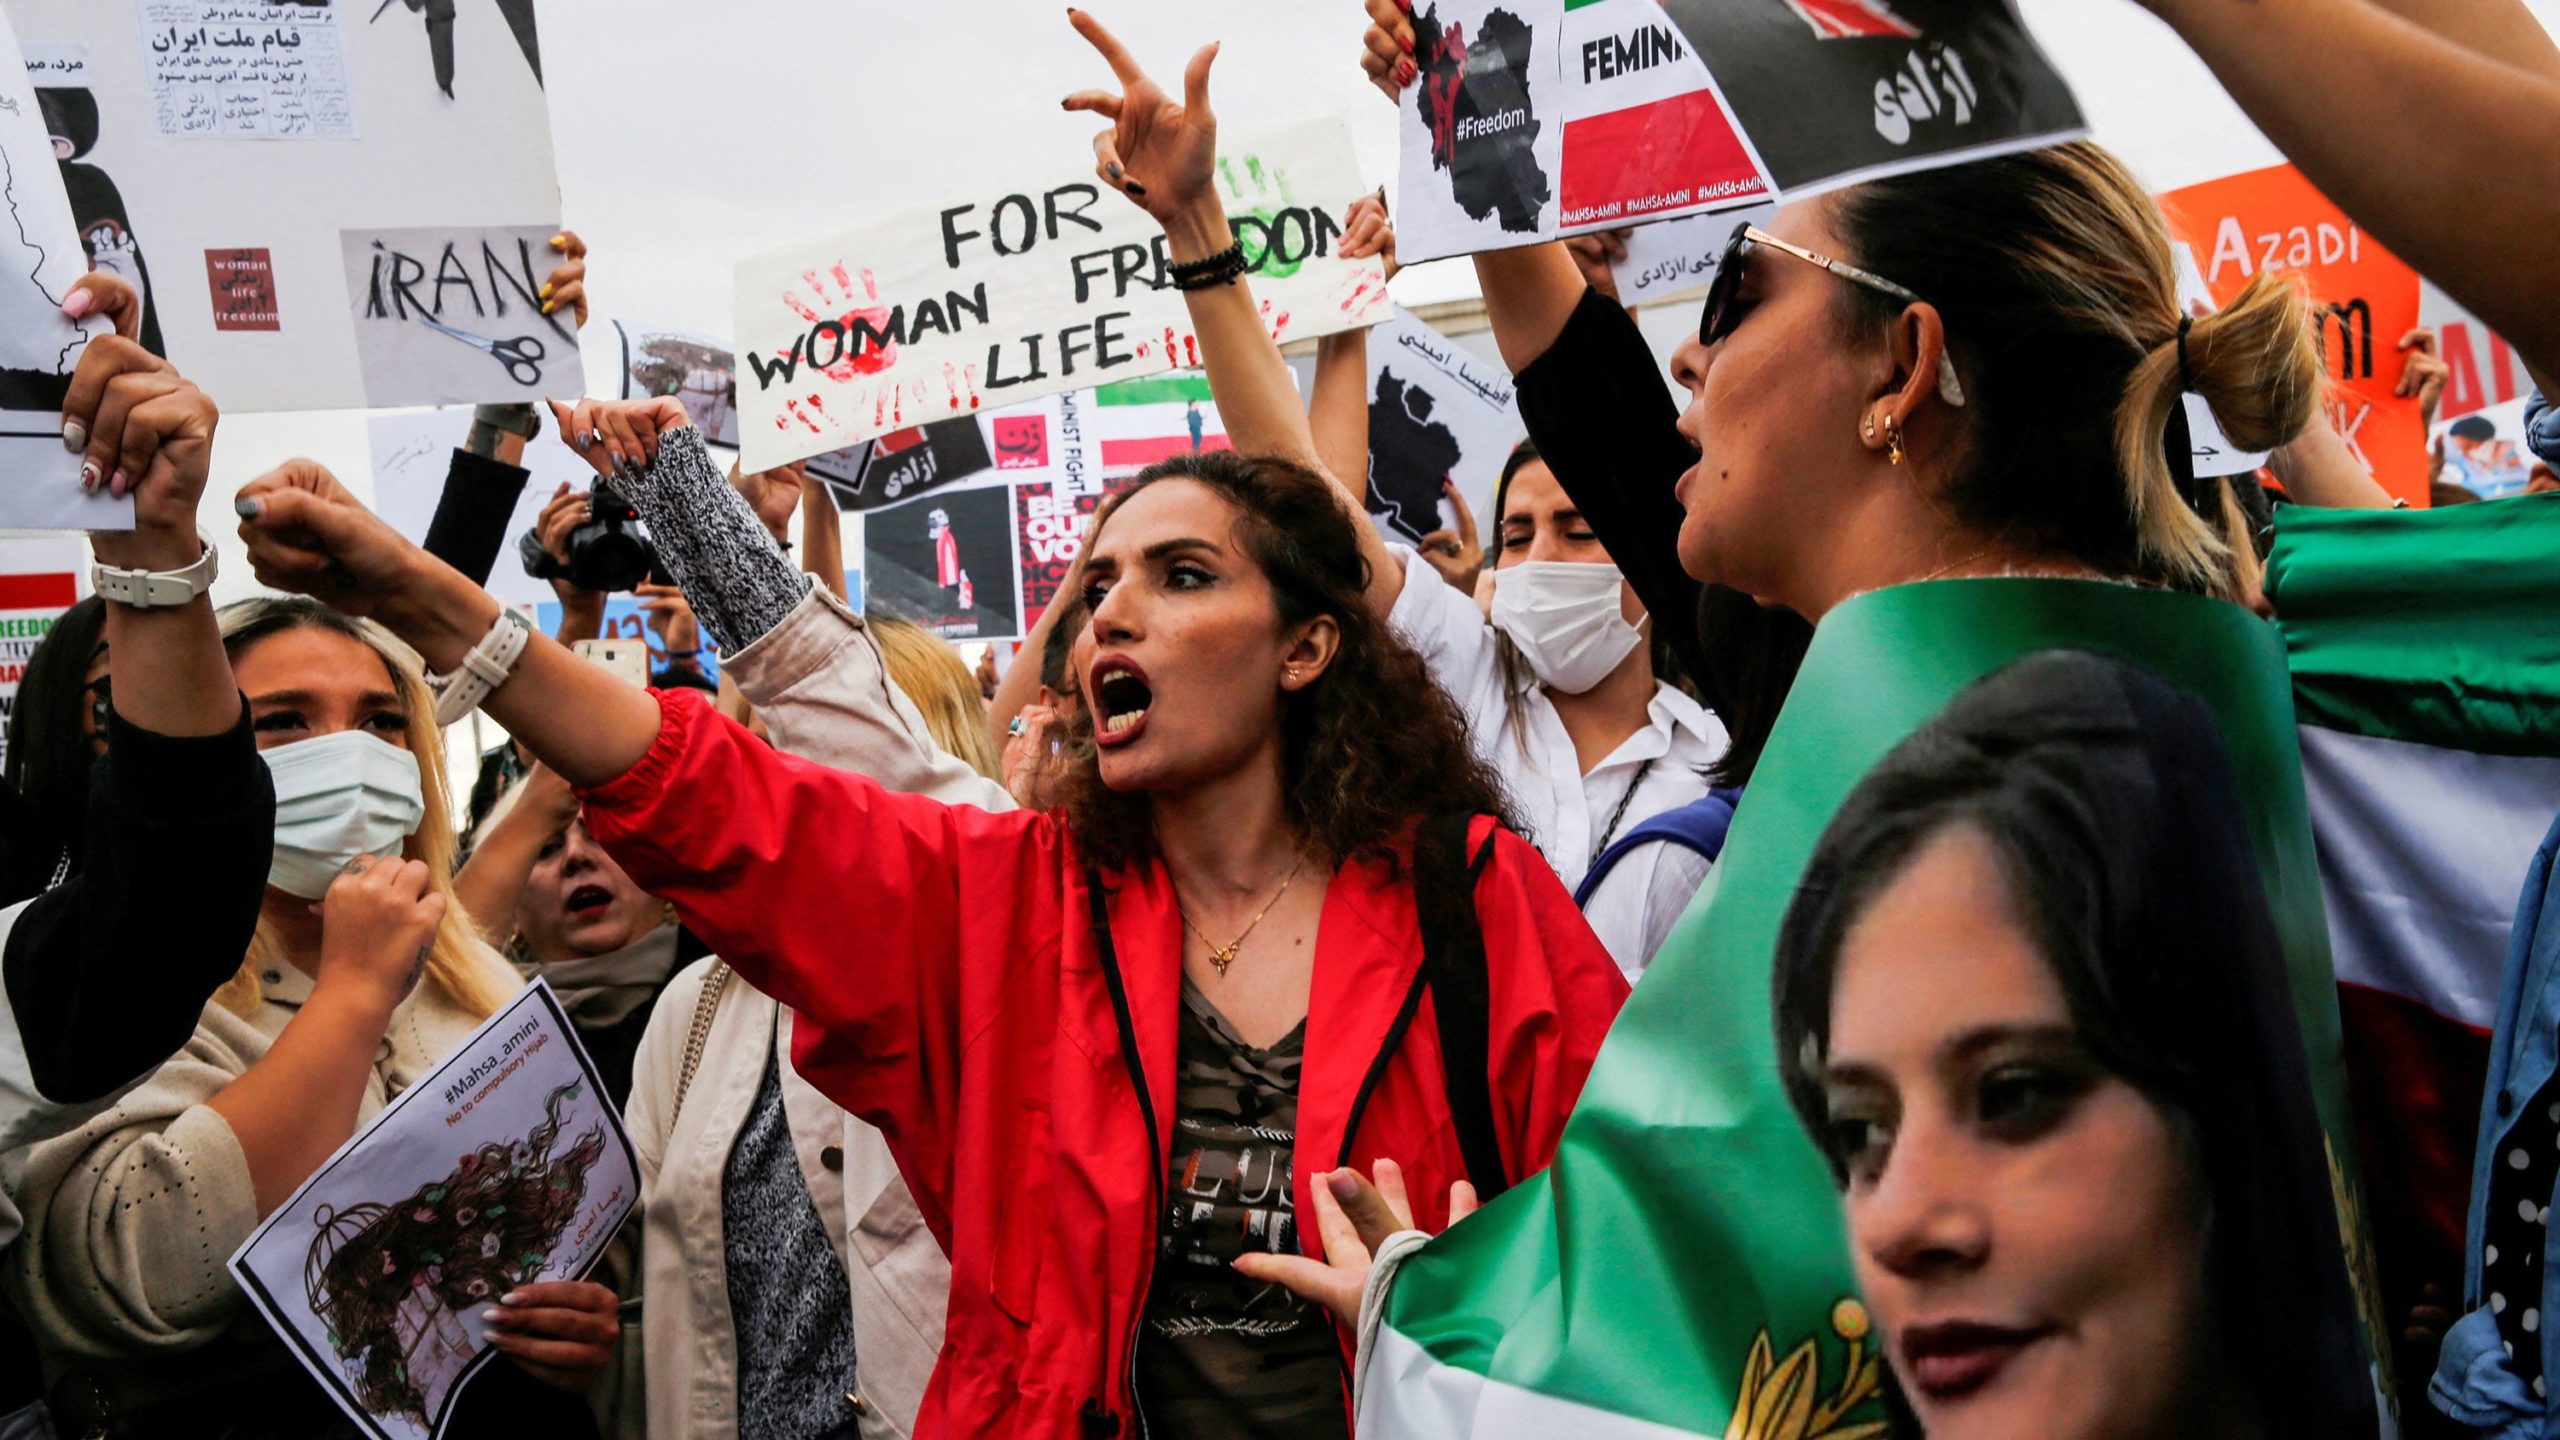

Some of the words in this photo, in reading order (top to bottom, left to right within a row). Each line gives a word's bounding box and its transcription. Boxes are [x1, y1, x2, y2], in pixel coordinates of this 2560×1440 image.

[152, 26, 206, 53] ایران
[213, 27, 255, 48] ملت
[262, 26, 301, 54] قیام
[1456, 107, 1525, 141] #Freedom
[1562, 201, 1622, 224] #MAHSA-AMINI
[1626, 188, 1691, 213] #MAHSA-AMINI
[1698, 176, 1766, 200] #MAHSA-AMIN
[940, 183, 1103, 268] FOR
[214, 260, 268, 271] woman
[231, 287, 258, 298] life
[215, 311, 280, 322] freedom
[746, 282, 990, 391] WOMAN
[984, 311, 1134, 389] LIFE
[1060, 389, 1081, 442] MINIST
[1064, 449, 1086, 491] FIGHT
[444, 1014, 540, 1105] #Mahsa_amini
[446, 1110, 462, 1128] No
[461, 1101, 474, 1115] to
[473, 1054, 525, 1105] compulsory
[523, 1033, 549, 1058] Hijab
